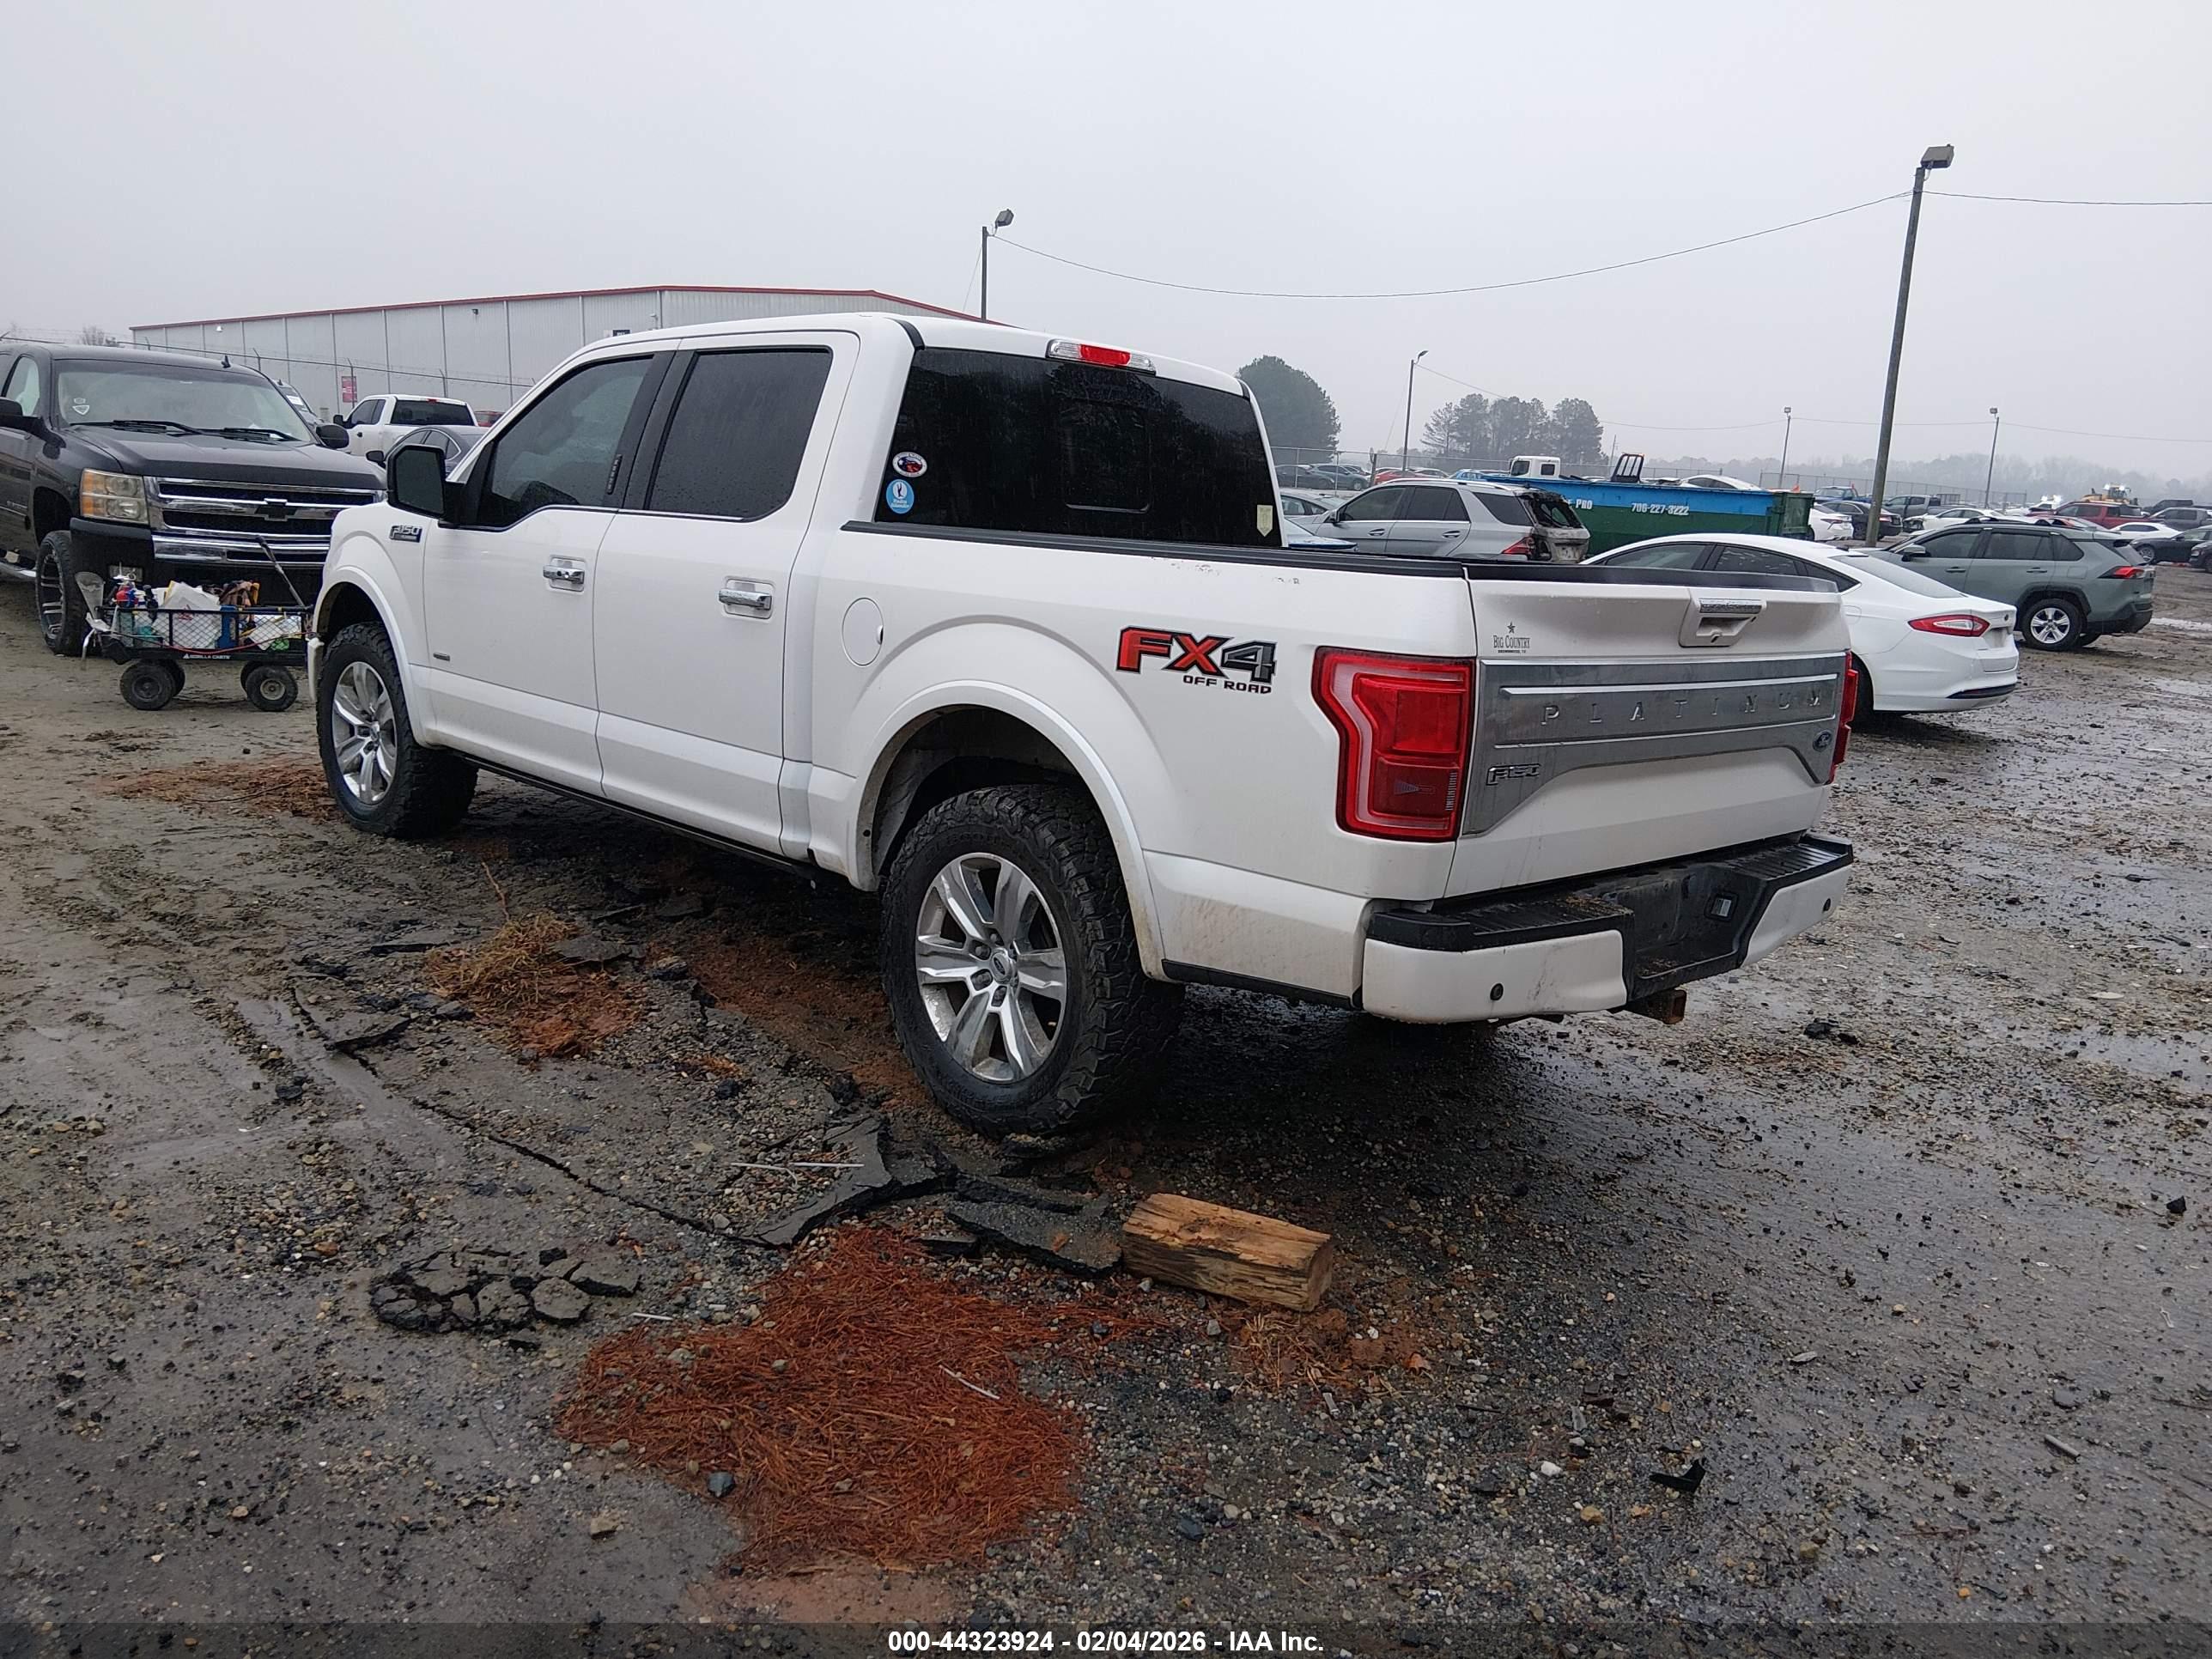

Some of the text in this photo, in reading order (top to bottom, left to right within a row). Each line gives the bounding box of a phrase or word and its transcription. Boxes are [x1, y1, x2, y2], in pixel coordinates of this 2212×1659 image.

[1575, 498, 1593, 510] PRO
[1115, 625, 1278, 684] FX4
[1182, 675, 1273, 694] OFF ROAD
[1540, 689, 1821, 725] PLATINUM
